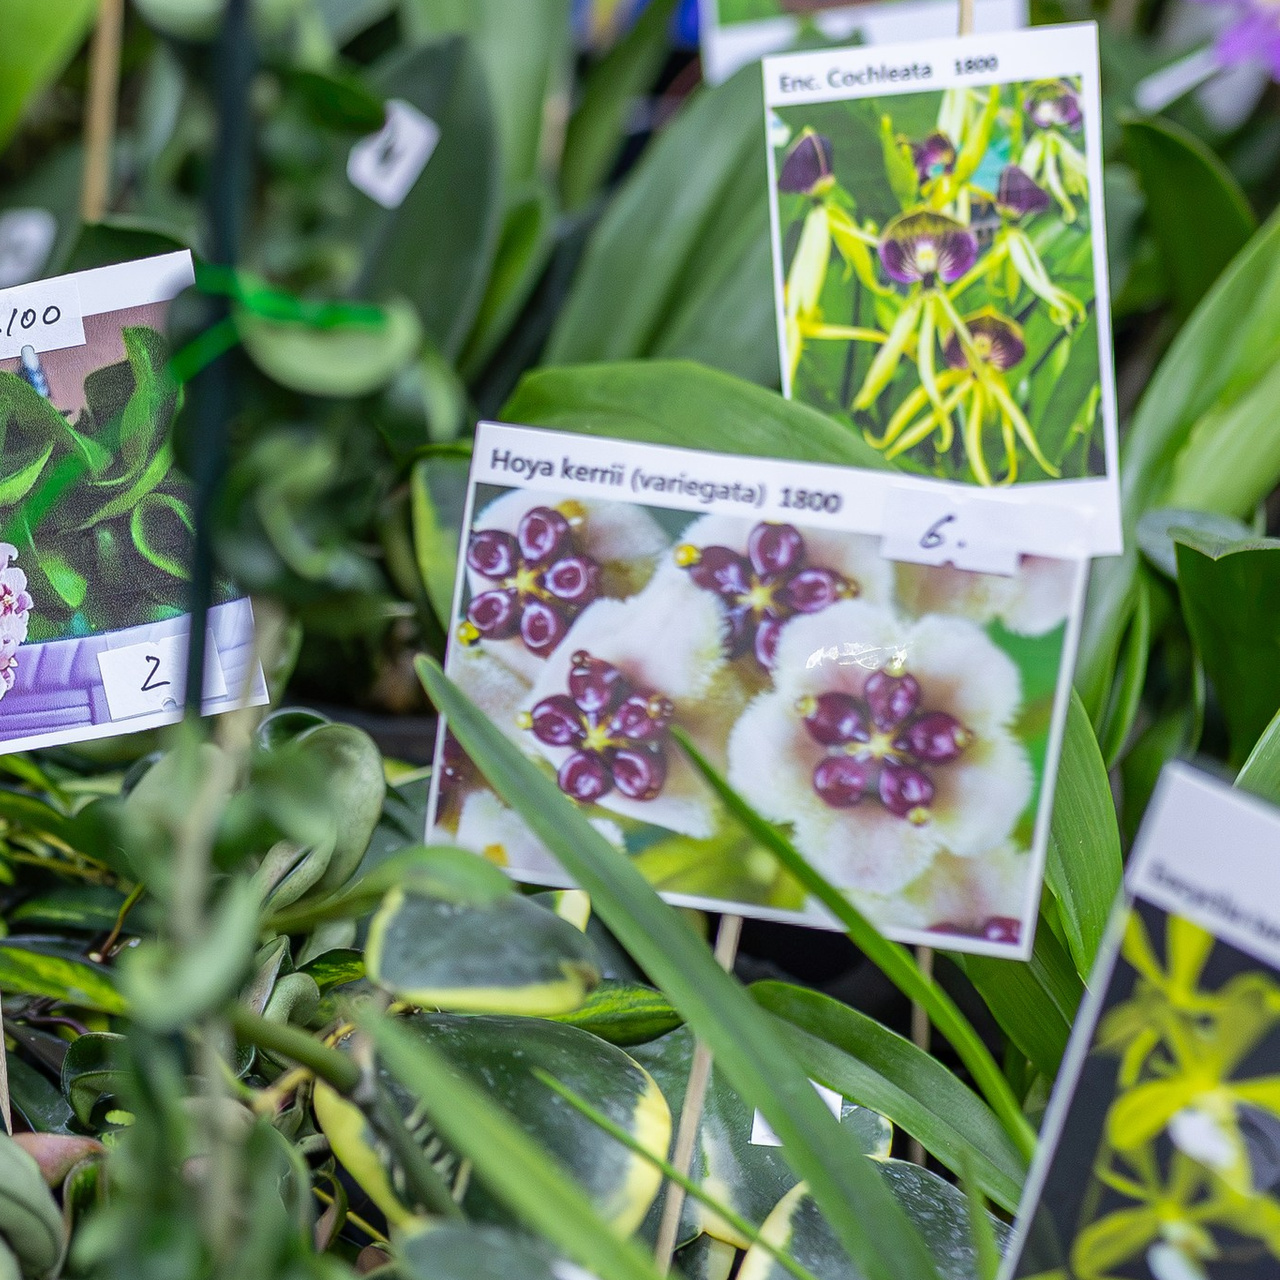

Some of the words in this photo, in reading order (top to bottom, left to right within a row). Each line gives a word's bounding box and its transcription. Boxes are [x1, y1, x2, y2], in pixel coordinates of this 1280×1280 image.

[826, 62, 934, 89] Cochleata
[953, 54, 1000, 76] 1800
[490, 448, 554, 479] Hoya
[559, 456, 624, 486] kerrii
[631, 468, 768, 508] (variegata)
[779, 486, 844, 515] 1800
[140, 655, 171, 692] 2
